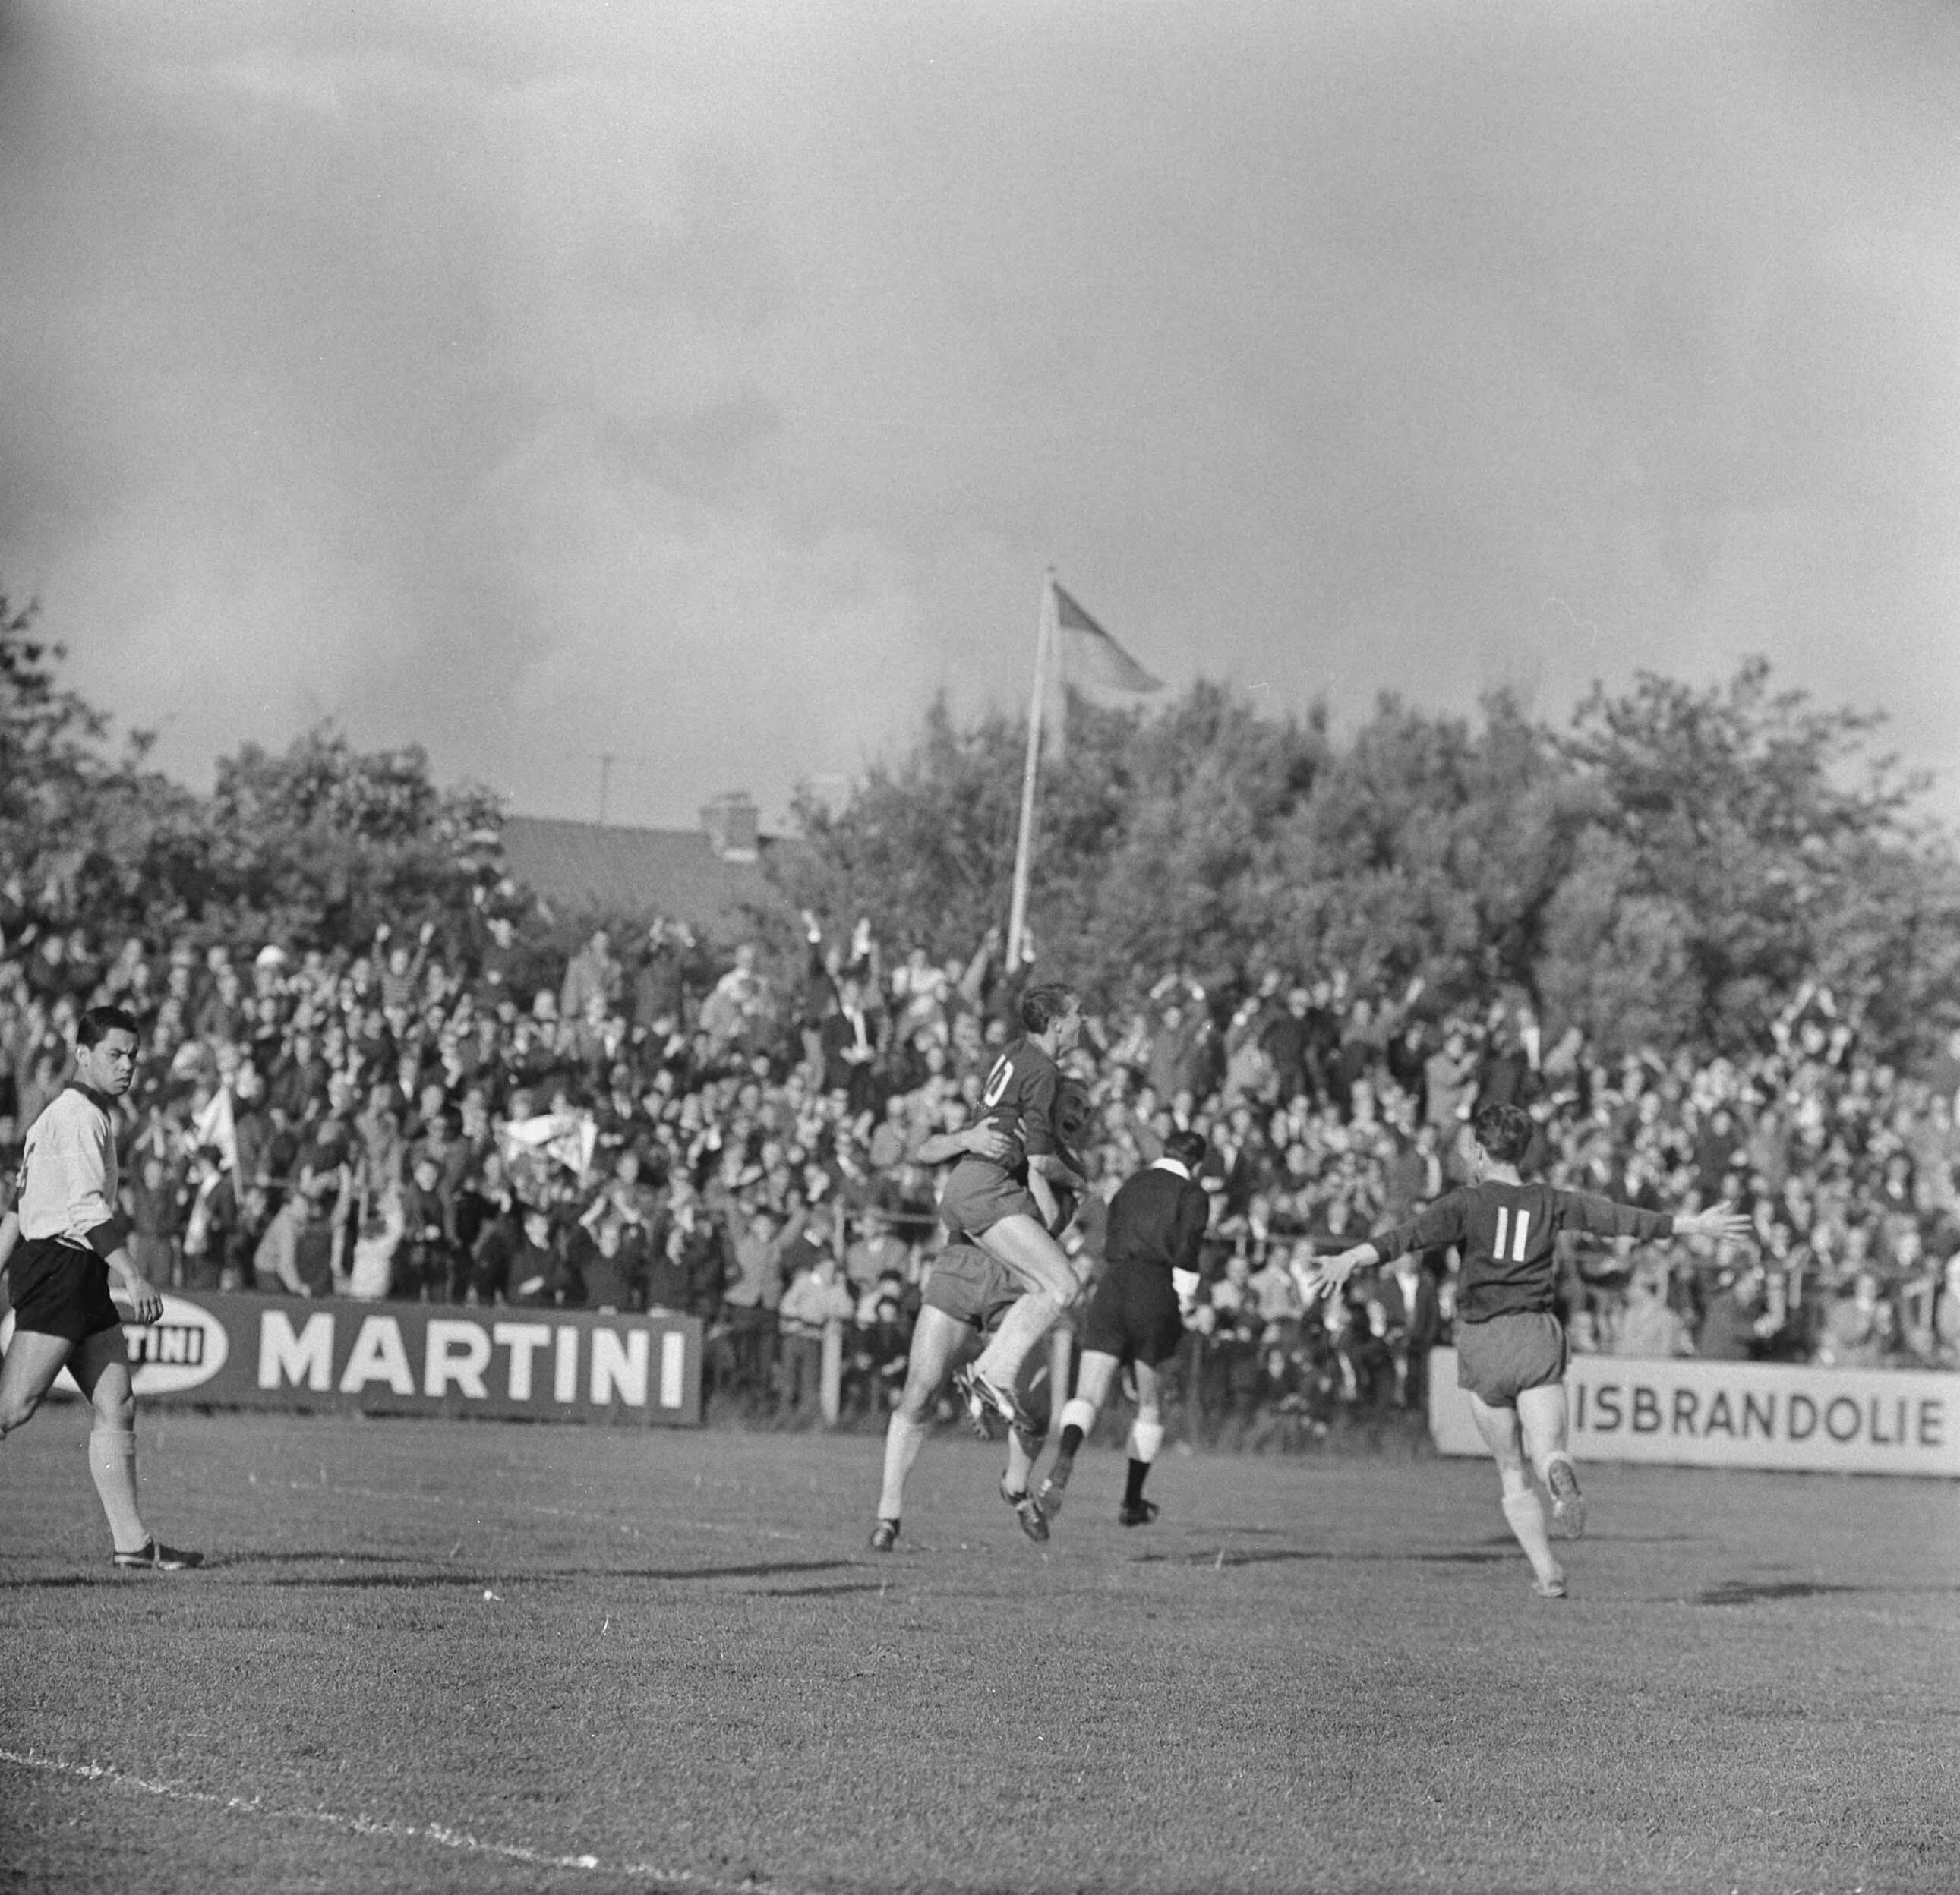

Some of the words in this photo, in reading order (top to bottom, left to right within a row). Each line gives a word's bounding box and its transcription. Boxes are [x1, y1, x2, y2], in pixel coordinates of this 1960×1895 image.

[1492, 1206, 1531, 1262] 11
[122, 1324, 200, 1364] TINI
[257, 1310, 685, 1408] MARTINI
[1576, 1383, 1944, 1447] ISBRANDOLIE
